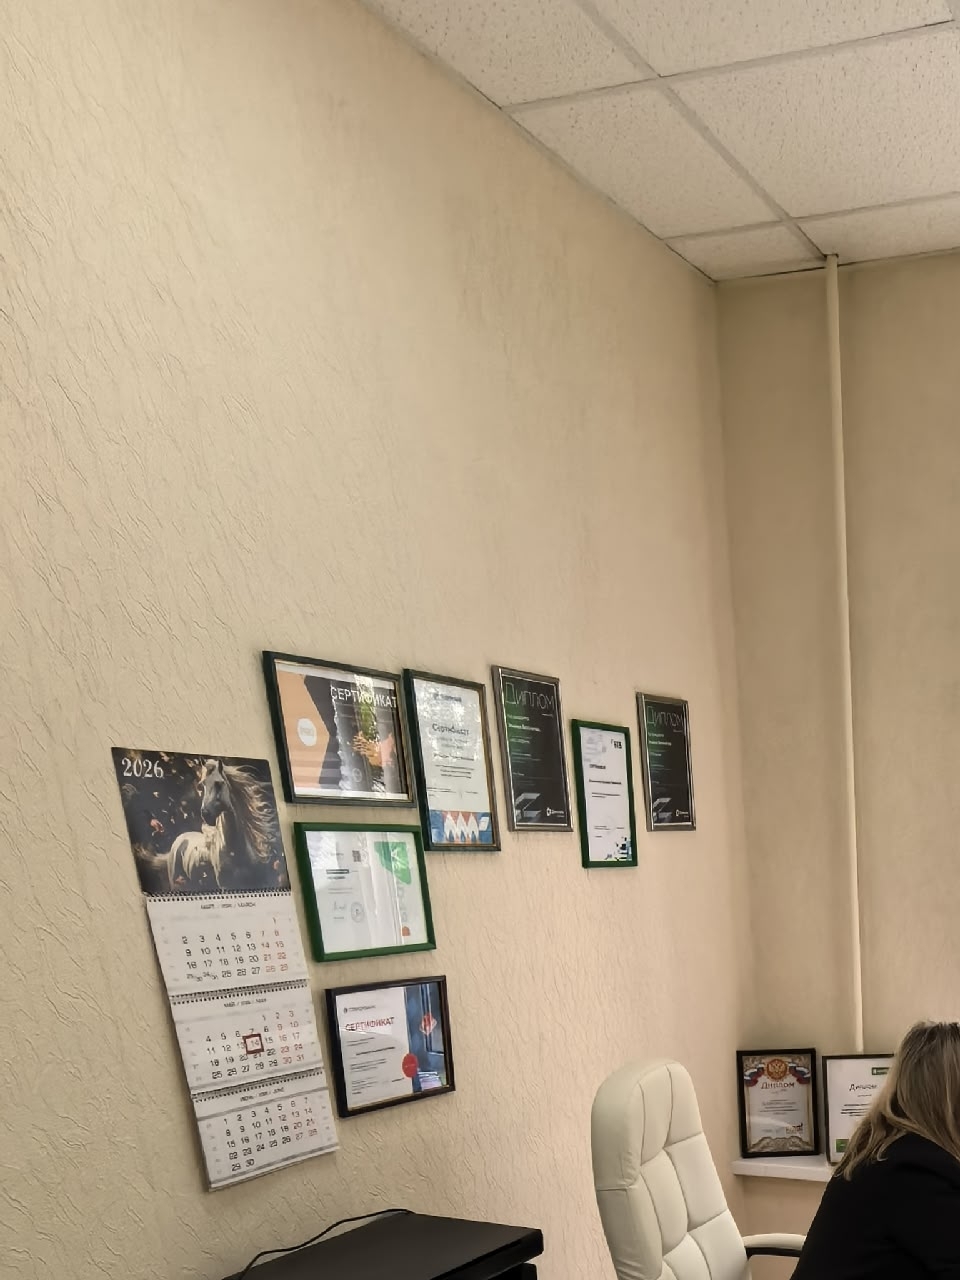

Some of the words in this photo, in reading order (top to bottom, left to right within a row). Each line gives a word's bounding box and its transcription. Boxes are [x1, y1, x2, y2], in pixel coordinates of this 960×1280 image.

[330, 686, 397, 708] СЕРТИФИКАТ
[121, 757, 164, 778] 2026
[345, 1016, 395, 1032] СЕРТИФИКАТ
